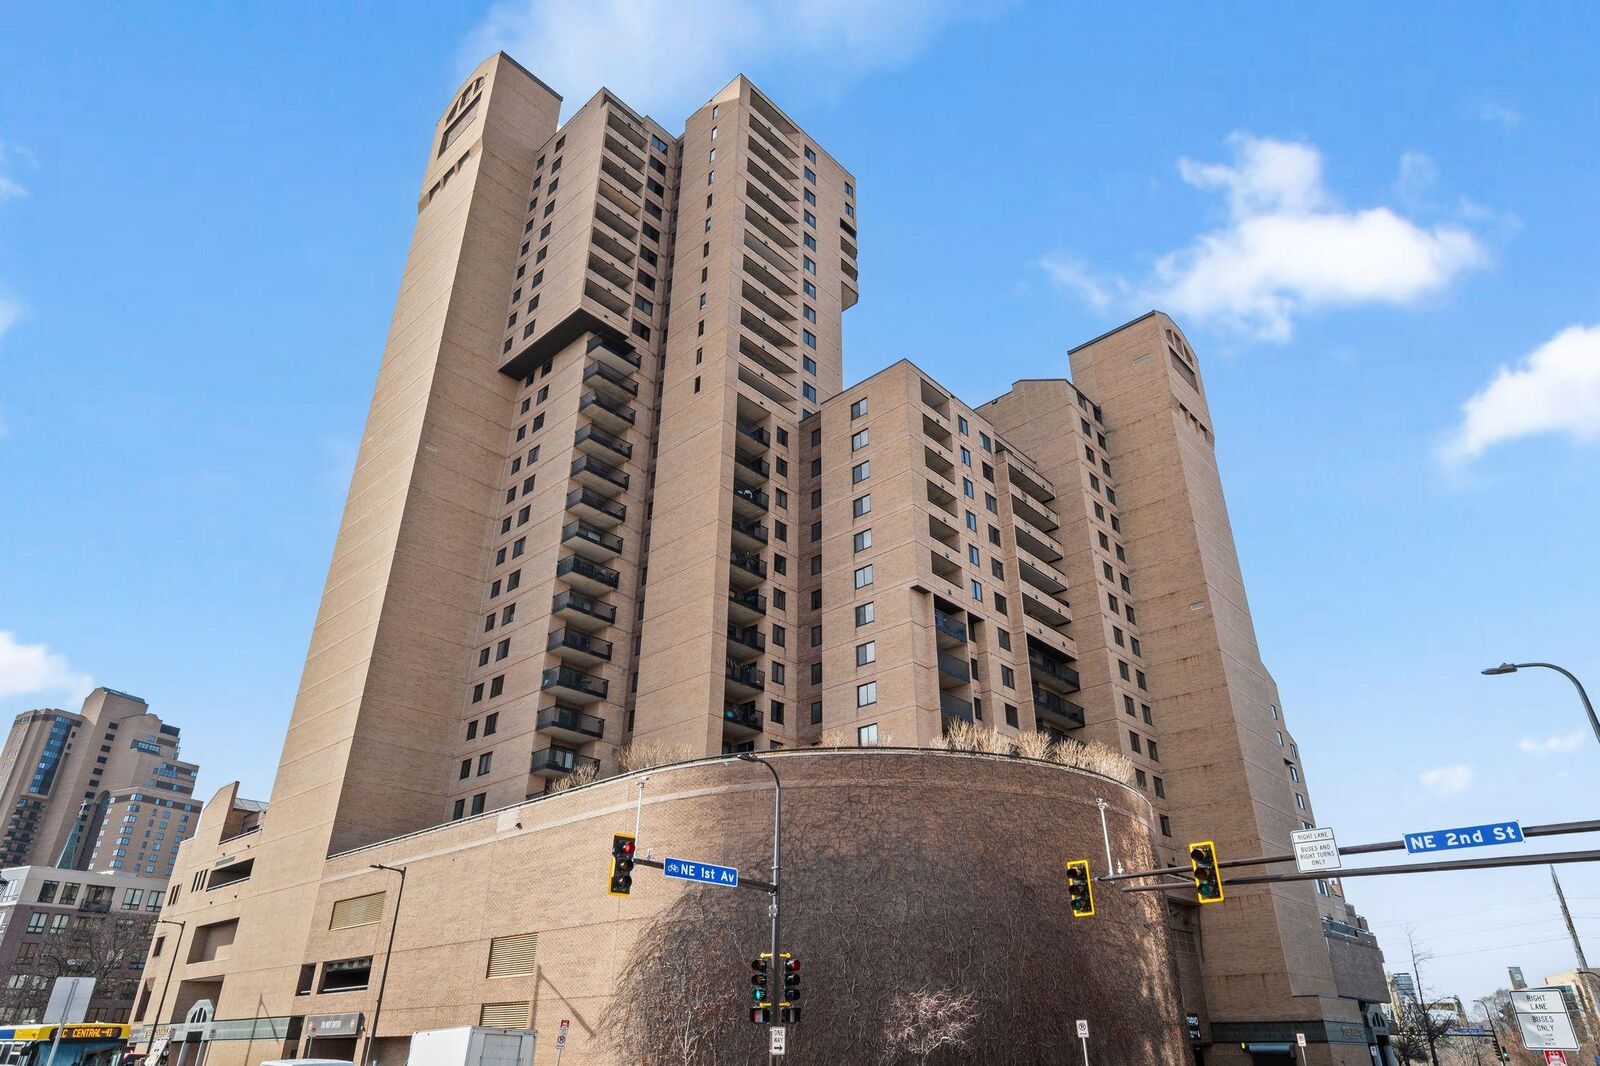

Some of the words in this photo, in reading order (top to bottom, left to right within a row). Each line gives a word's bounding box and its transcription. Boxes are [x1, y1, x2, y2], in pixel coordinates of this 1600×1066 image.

[1314, 831, 1329, 839] LANE
[1410, 835, 1437, 850] NE
[1445, 830, 1484, 846] 2nd
[1493, 826, 1516, 841] St
[1301, 845, 1319, 853] BUSES
[1319, 843, 1331, 851] AND
[1300, 853, 1316, 861] RIGHT
[1317, 850, 1335, 859] TURNS
[1311, 858, 1326, 866] ONLY
[680, 863, 696, 877] NE
[701, 867, 716, 880] 1st
[721, 870, 735, 882] Av
[1526, 994, 1546, 1002] RIGHT
[1530, 1003, 1548, 1011] LANE
[1532, 1015, 1554, 1023] BUSES
[72, 1028, 113, 1039] CENTRAL-41
[774, 1029, 784, 1037] ONE
